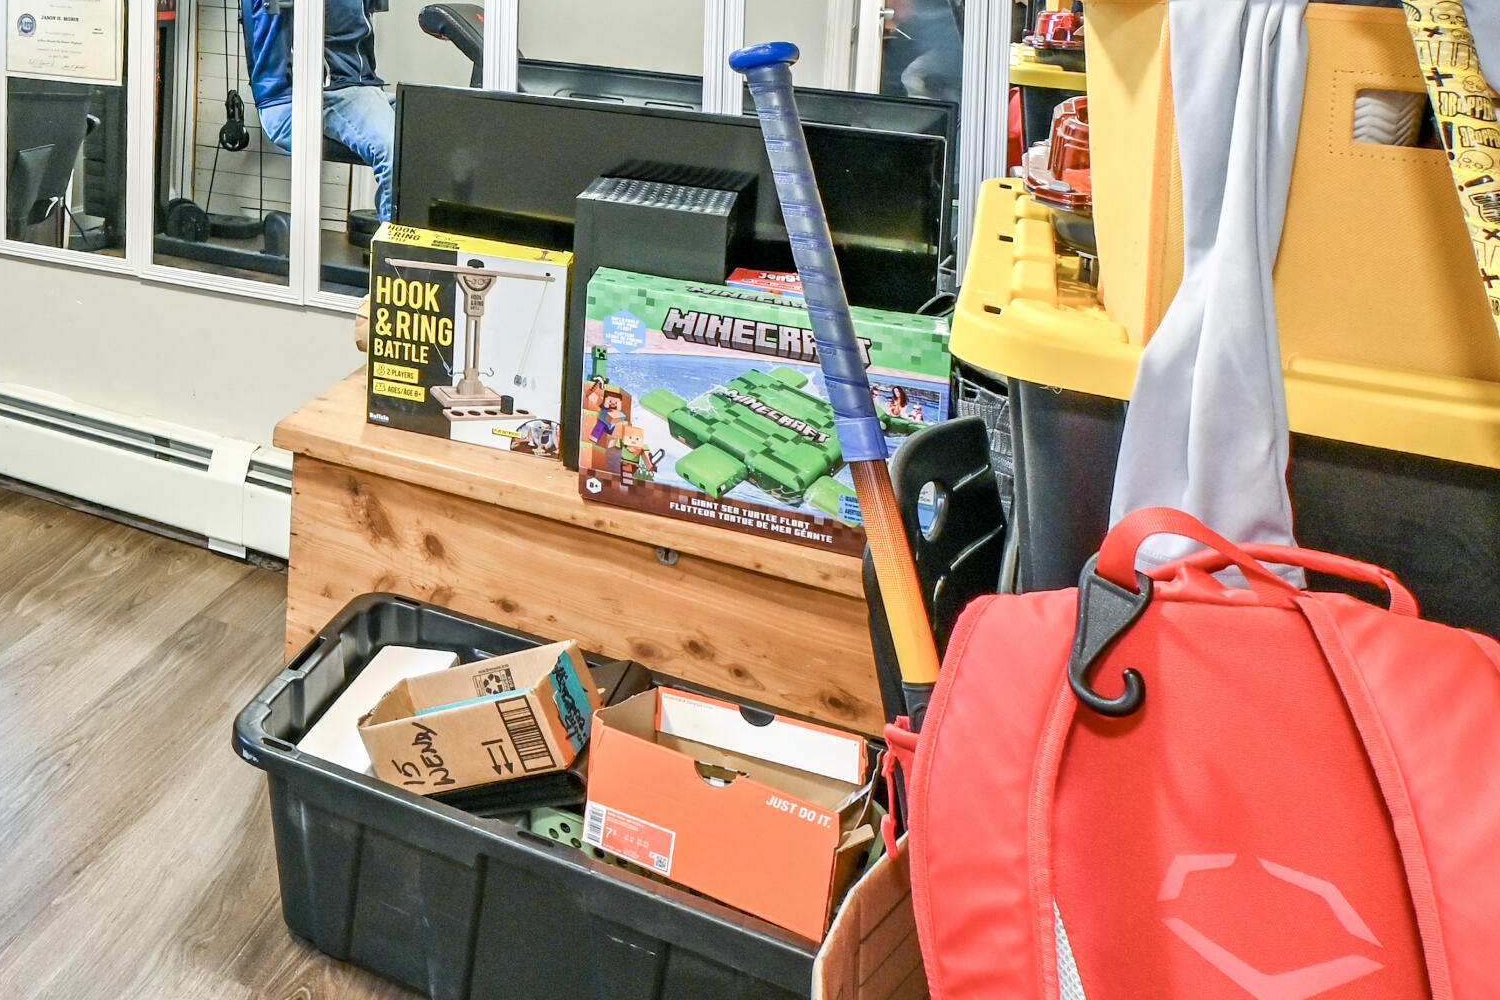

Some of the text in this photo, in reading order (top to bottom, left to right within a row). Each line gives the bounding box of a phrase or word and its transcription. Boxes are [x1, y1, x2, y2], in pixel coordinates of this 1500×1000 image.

[388, 224, 417, 234] HOOK
[394, 232, 420, 240] RING
[376, 276, 440, 313] HOOK
[374, 308, 453, 346] & RING
[661, 307, 873, 369] MINECRAT
[374, 338, 429, 364] BATTLE
[386, 368, 414, 380] 2 PLAYERS
[724, 388, 831, 444] MINECRAFT
[670, 502, 833, 544] FLOTTEUR TORTUE DE MER GÉANTE
[691, 498, 810, 530] GIANT SEA TURTLE FLOAT
[765, 795, 832, 828] JUST DO IT.
